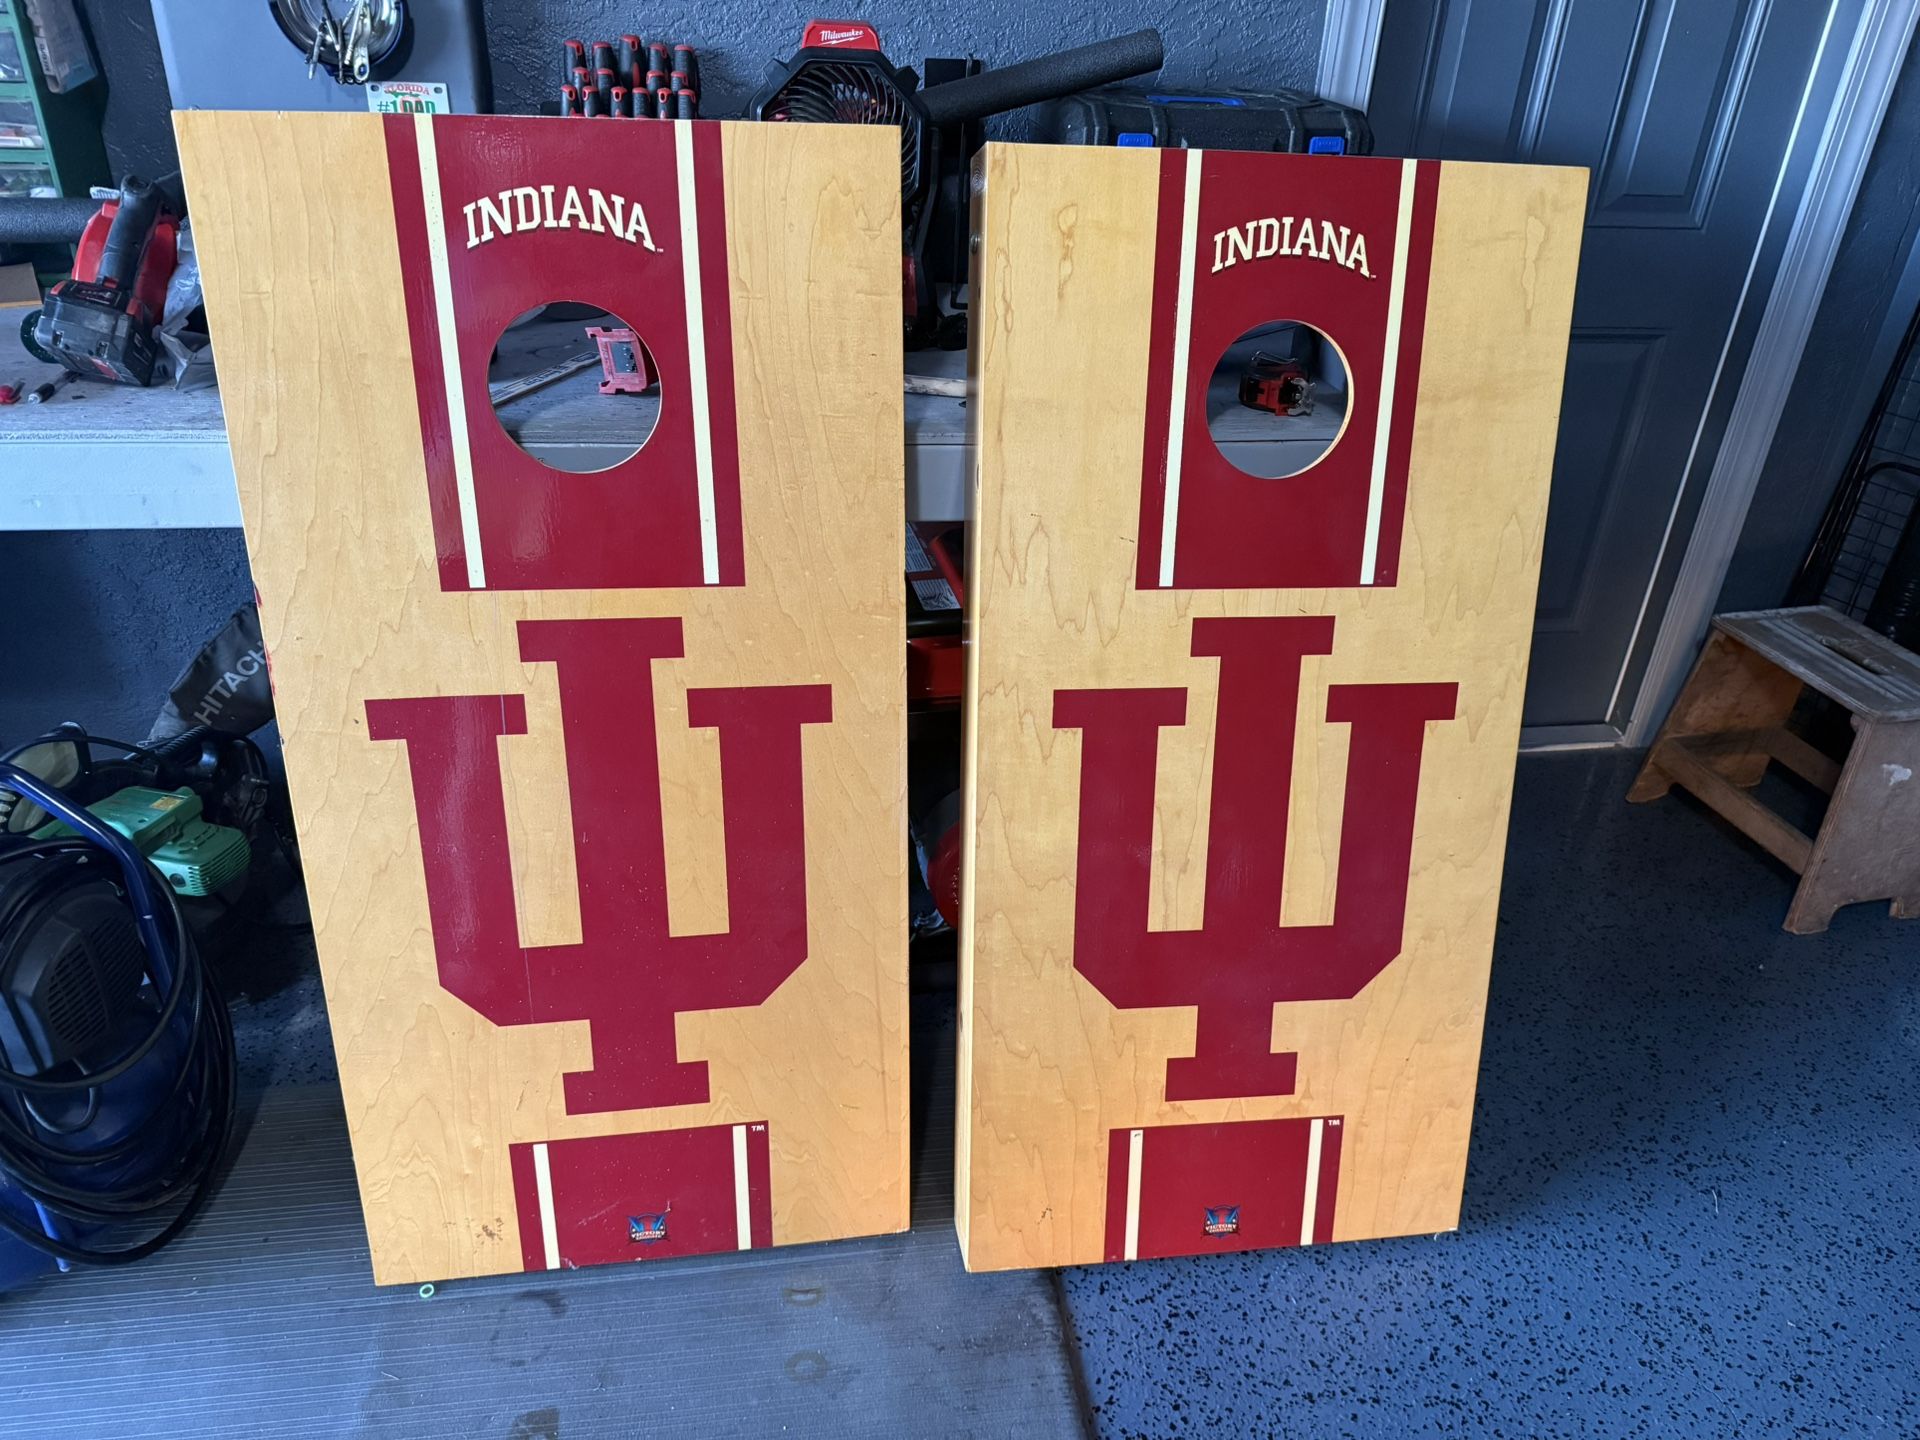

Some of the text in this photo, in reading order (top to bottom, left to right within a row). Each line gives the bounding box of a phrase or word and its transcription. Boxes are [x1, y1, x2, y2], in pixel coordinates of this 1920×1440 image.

[820, 28, 864, 42] Milwaukee
[463, 184, 656, 253] INDIANA
[1211, 216, 1370, 279] INDIANA
[751, 1124, 765, 1132] TM
